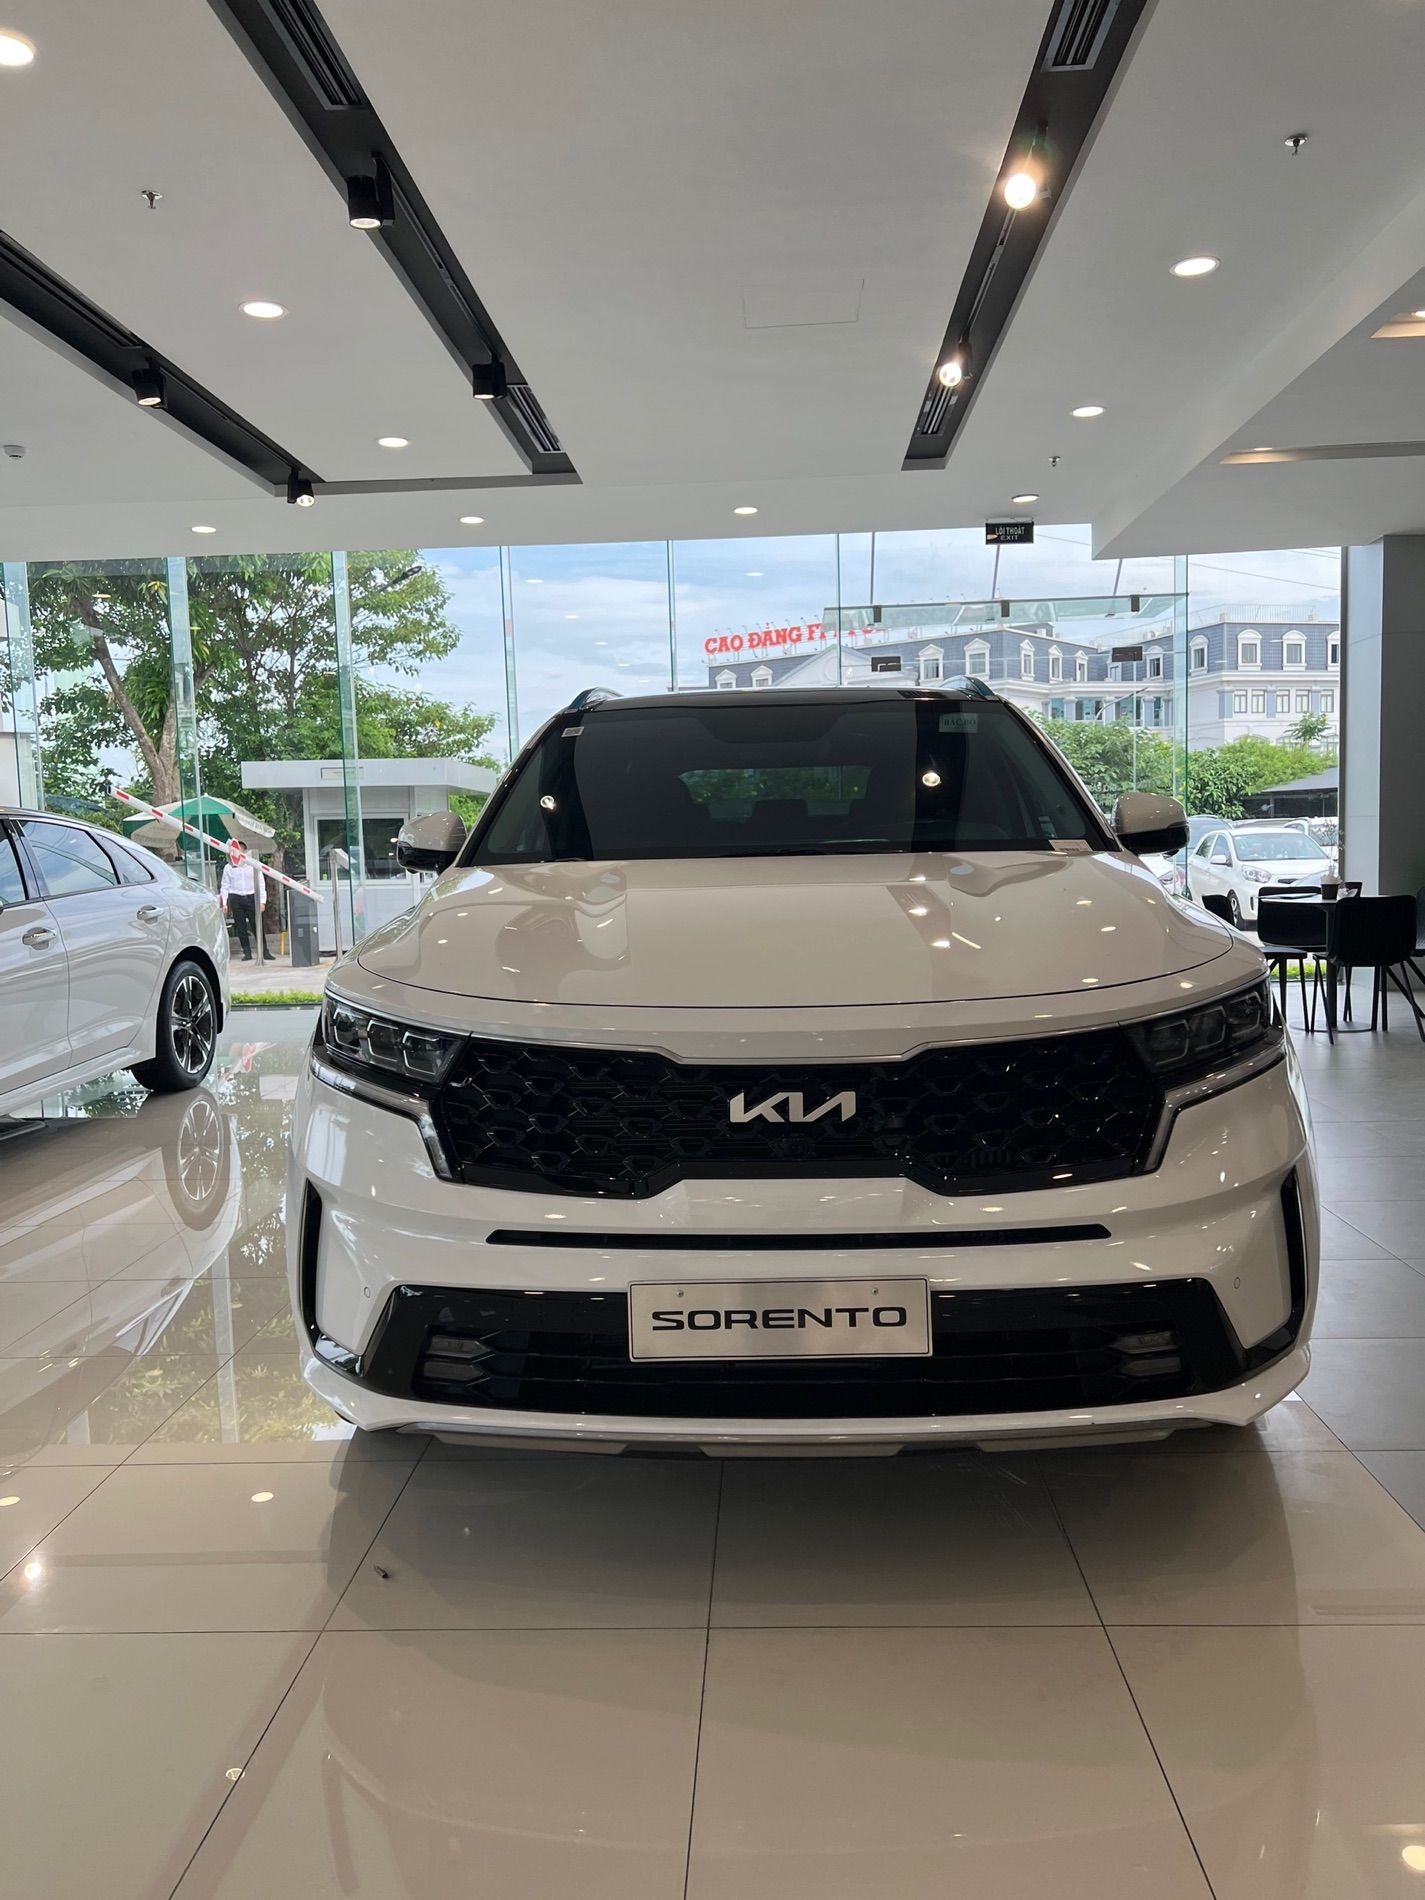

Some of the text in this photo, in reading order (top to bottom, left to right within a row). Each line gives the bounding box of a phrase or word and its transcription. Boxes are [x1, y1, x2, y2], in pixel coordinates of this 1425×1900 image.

[704, 635, 743, 654] CAO
[730, 1091, 857, 1122] KIA
[652, 1307, 907, 1331] SORENTO
